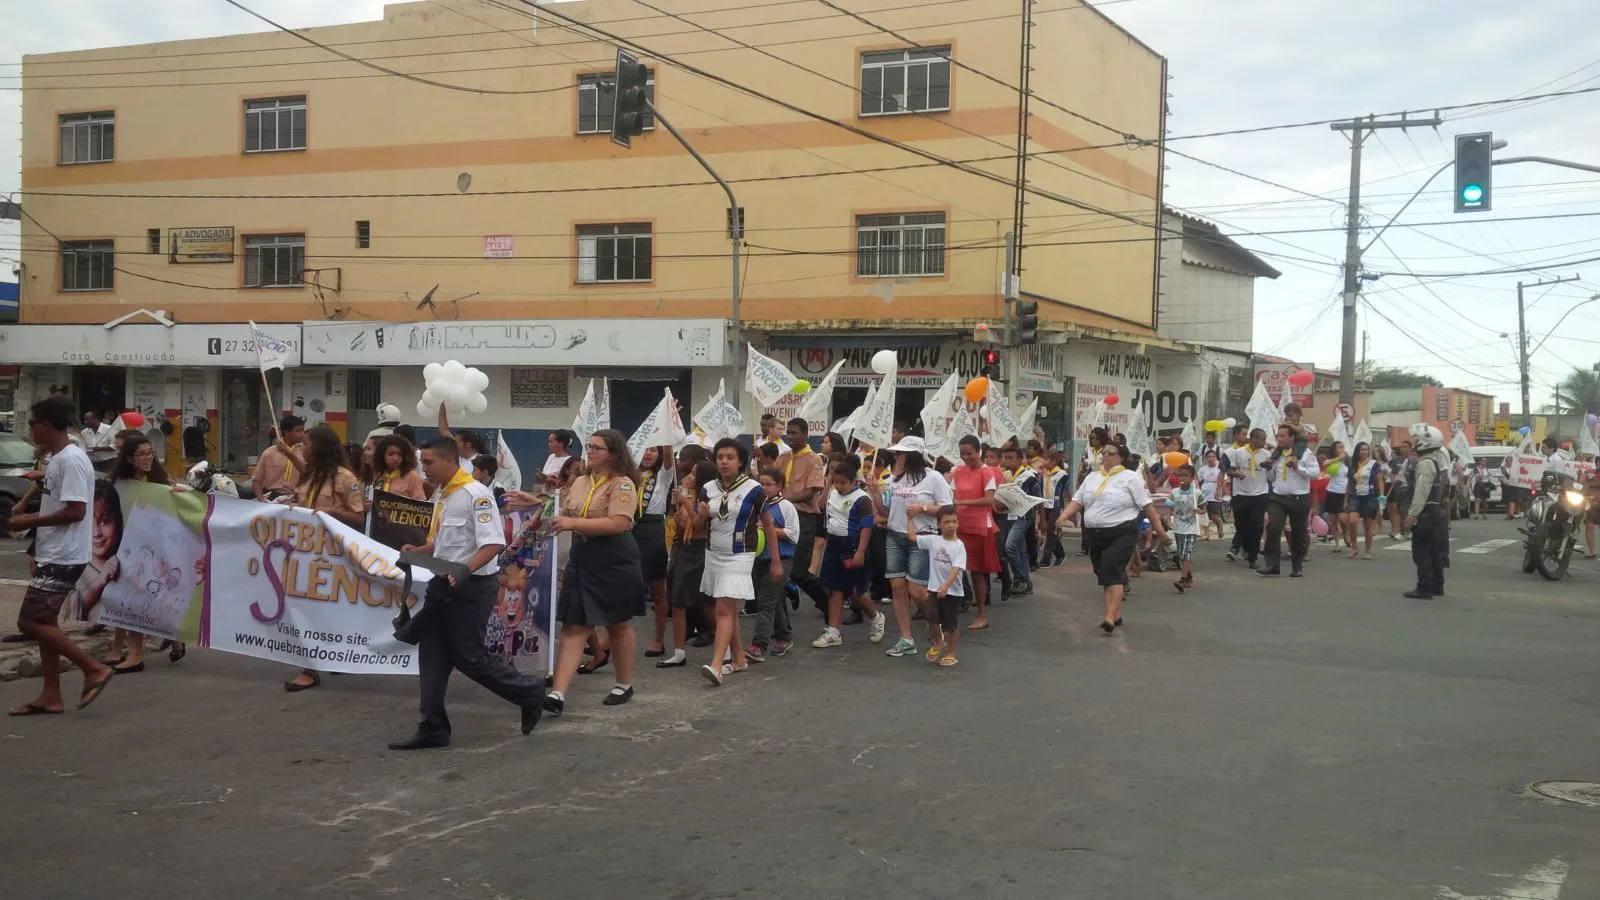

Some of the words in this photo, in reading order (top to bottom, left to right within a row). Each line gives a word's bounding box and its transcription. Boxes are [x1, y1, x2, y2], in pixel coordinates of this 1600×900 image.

[184, 229, 231, 239] ADVOGADA
[225, 341, 237, 352] 27
[62, 352, 90, 361] Casa
[842, 347, 879, 368] PAG
[750, 350, 789, 386] QUEBRANDO
[1098, 355, 1120, 377] PAGA
[1123, 354, 1151, 381] POUCO
[380, 500, 432, 514] QUEBRANDO
[105, 605, 122, 617] Viva
[124, 613, 137, 621] em
[276, 621, 300, 638] Visite
[304, 629, 343, 644] nosso
[346, 633, 371, 647] site:
[235, 633, 411, 668] www.quebrandoosilencio.org
